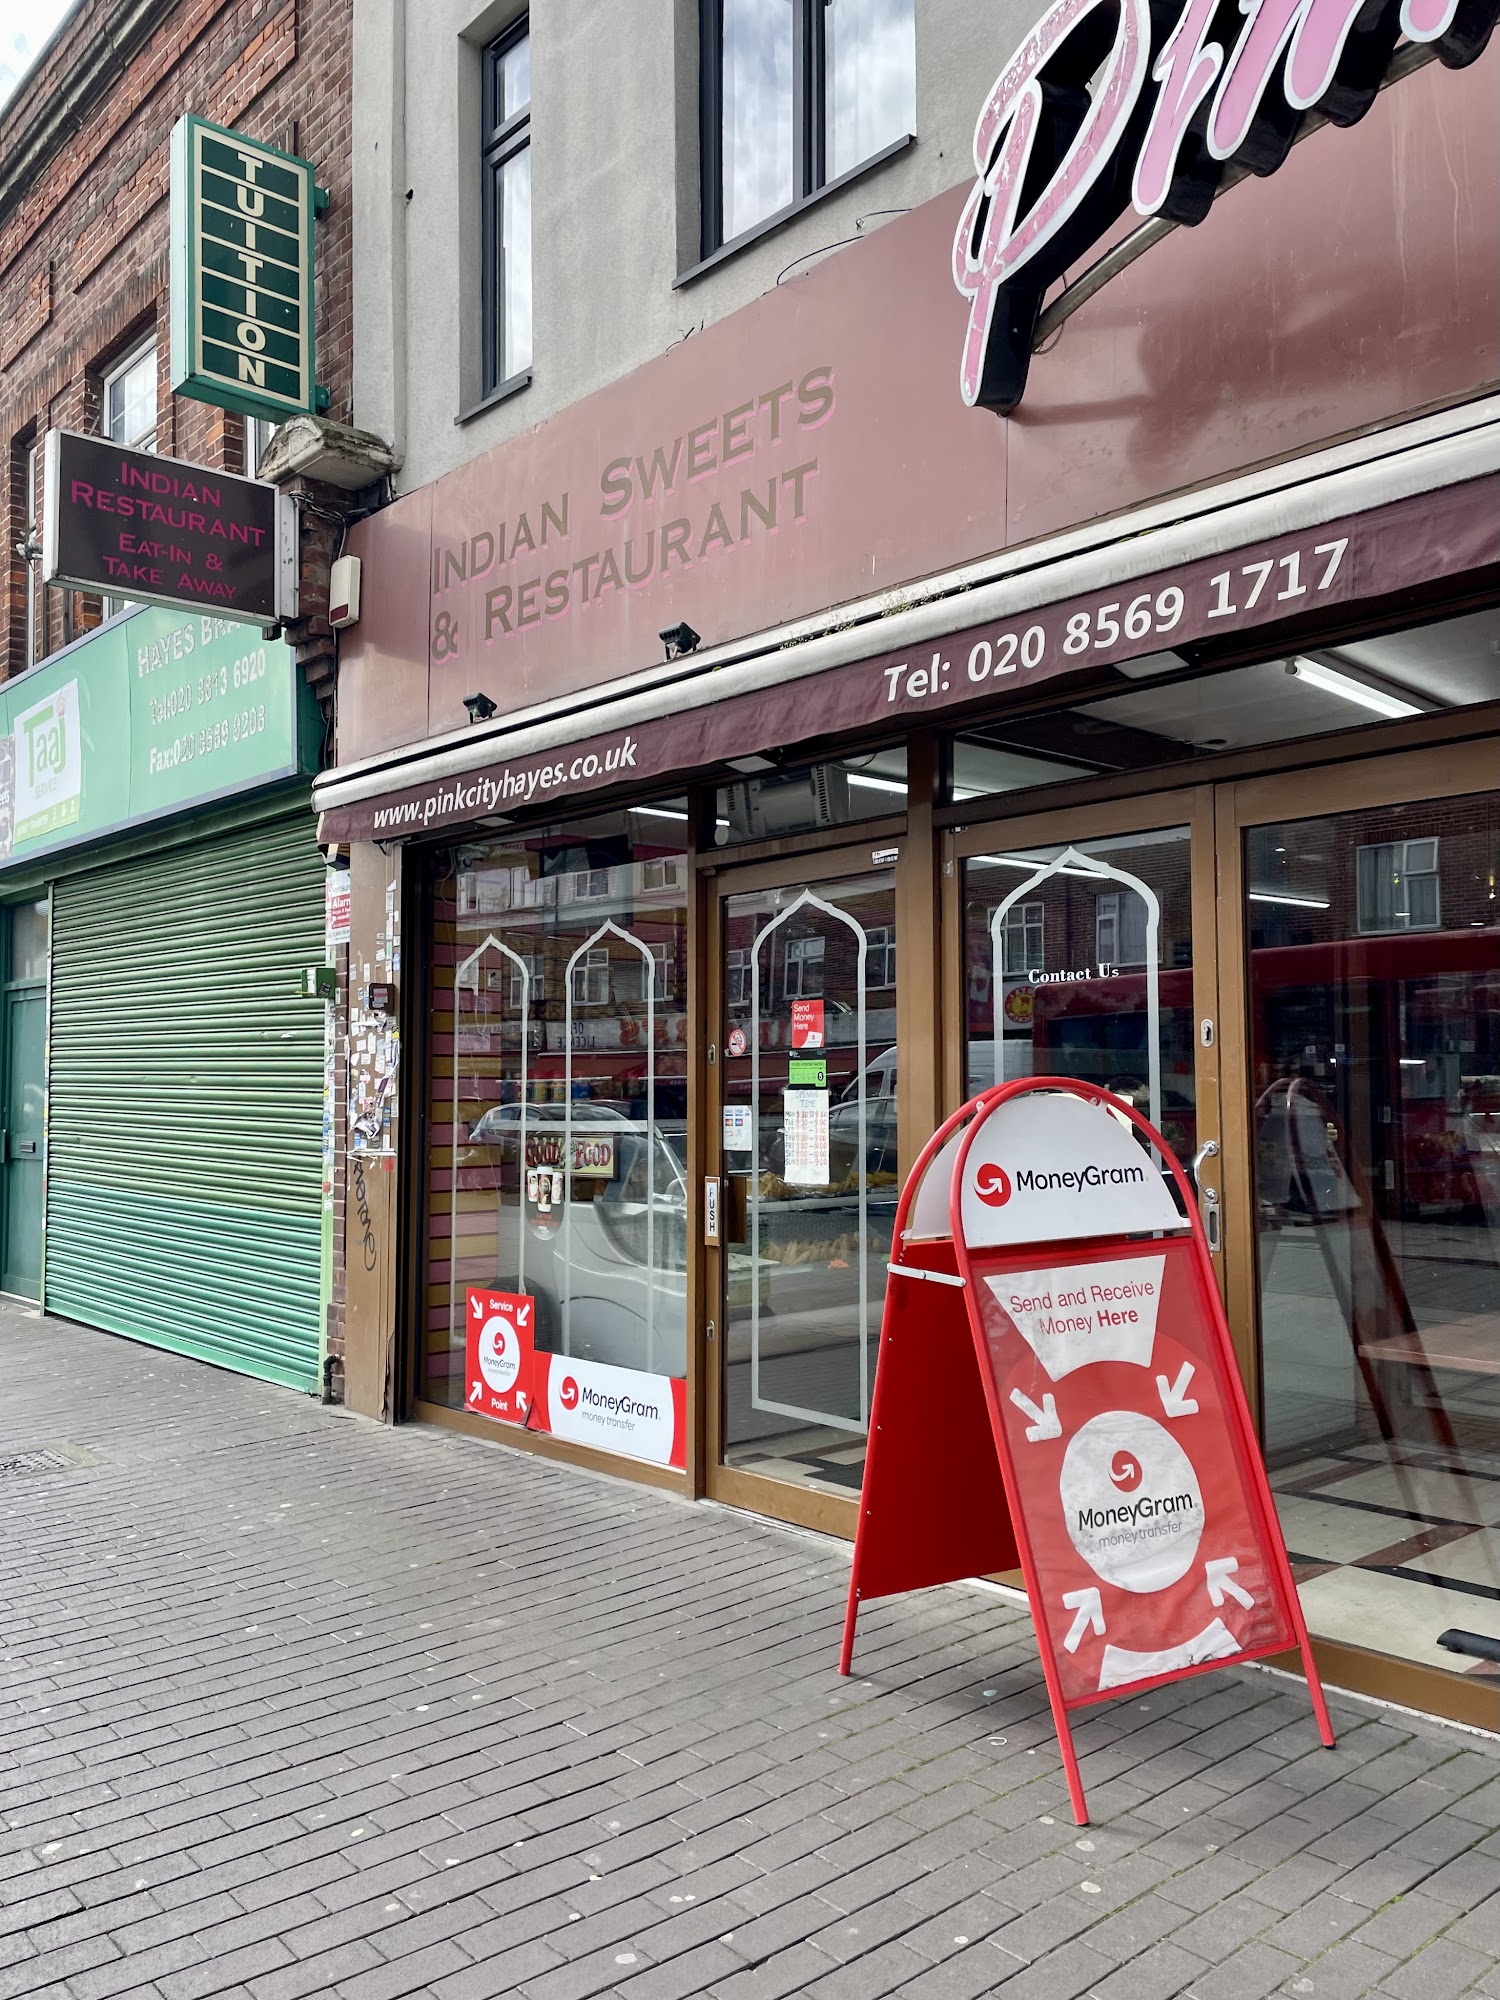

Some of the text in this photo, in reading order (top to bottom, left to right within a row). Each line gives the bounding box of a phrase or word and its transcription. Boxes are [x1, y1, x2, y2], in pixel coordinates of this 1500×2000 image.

[236, 152, 266, 388] TUITION
[121, 461, 221, 507] INDIAN
[433, 365, 837, 597] INDIAN SWEETS
[71, 480, 265, 546] RESTAURANT
[119, 533, 223, 572] EAT-IN &
[431, 457, 821, 664] & RESTAURANT
[102, 555, 238, 600] TAKE AWAY
[883, 537, 1349, 702] Tel: 020 8569 1717
[137, 624, 195, 678] HAYES
[233, 647, 266, 689] 6920
[23, 705, 66, 788] Taaj
[373, 736, 638, 828] www.pinkcityhayes.co.uk
[1028, 963, 1120, 984] Contact Us
[794, 1004, 810, 1013] Send
[794, 1014, 814, 1022] Money
[794, 1023, 809, 1031] Here
[800, 1100, 816, 1108] TIME
[574, 1141, 611, 1169] FOOD
[1016, 1165, 1144, 1193] MoneyGram
[489, 1299, 513, 1312] Service
[1010, 1281, 1155, 1313] Send and Receive
[1039, 1309, 1139, 1335] Money Here
[484, 1356, 515, 1369] MoneyGram
[491, 1398, 508, 1411] Point
[582, 1387, 658, 1420] MoneyGram
[582, 1411, 635, 1431] money transfer
[1078, 1494, 1193, 1531] MoneyGram
[1099, 1520, 1182, 1548] money transfer
